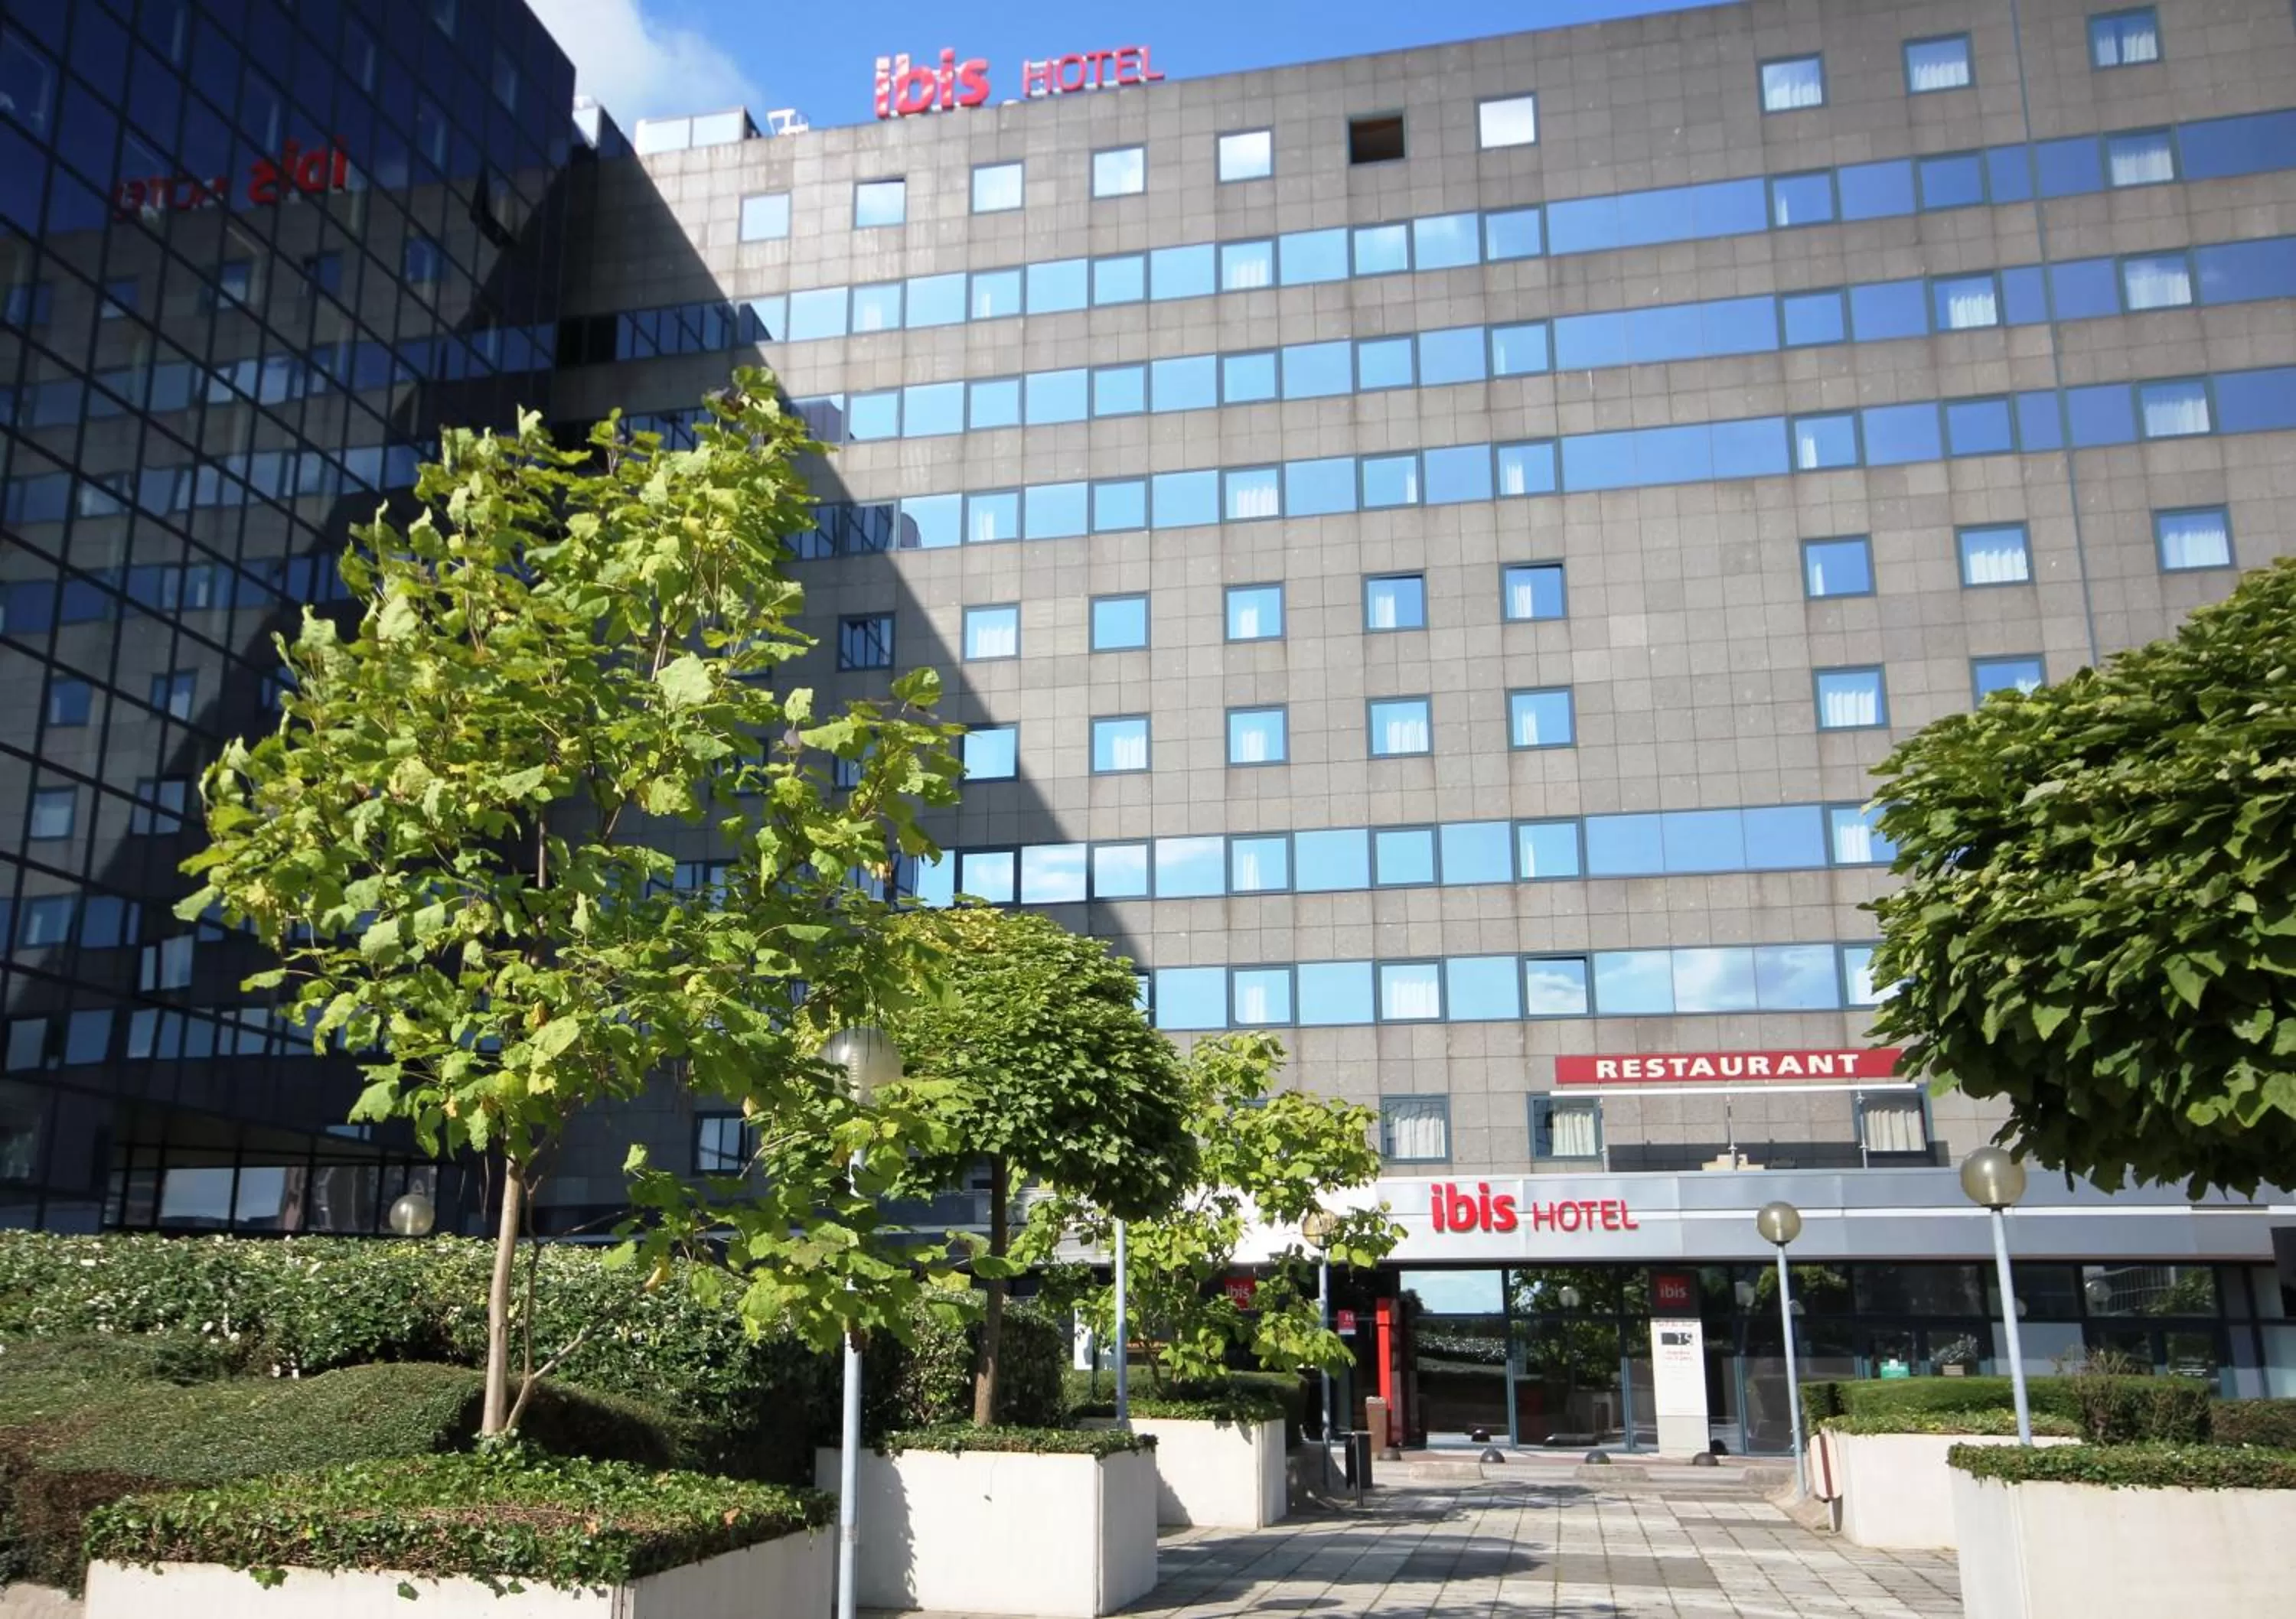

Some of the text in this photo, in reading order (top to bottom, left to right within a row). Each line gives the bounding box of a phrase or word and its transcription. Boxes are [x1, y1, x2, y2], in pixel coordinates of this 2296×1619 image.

[876, 45, 1165, 119] ibis HOTEL
[1596, 1054, 1859, 1080] RESTAURANT
[1431, 1182, 1639, 1233] ibis HOTEL
[1225, 1285, 1251, 1298] ibis
[1659, 1283, 1688, 1298] ibis
